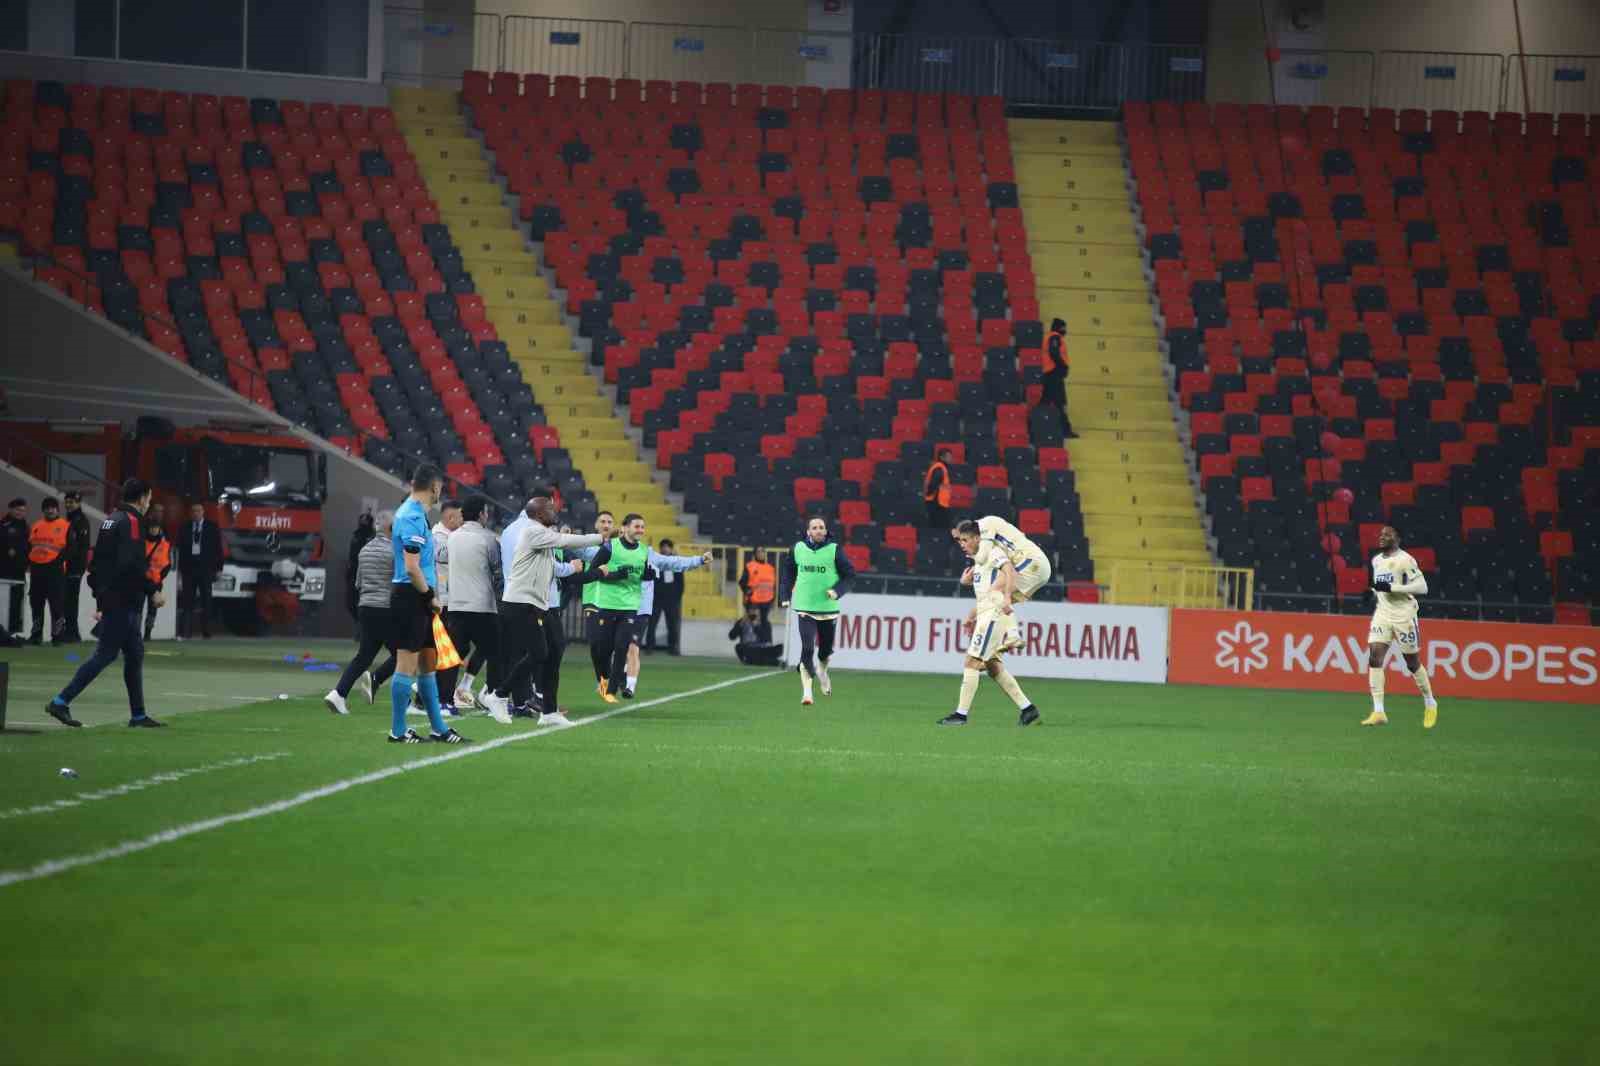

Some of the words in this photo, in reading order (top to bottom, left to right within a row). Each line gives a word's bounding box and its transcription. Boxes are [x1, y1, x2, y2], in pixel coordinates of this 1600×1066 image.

[974, 634, 983, 646] 3
[1399, 631, 1417, 644] 29
[1283, 632, 1411, 678] KAYA
[1427, 640, 1598, 687] ROPES
